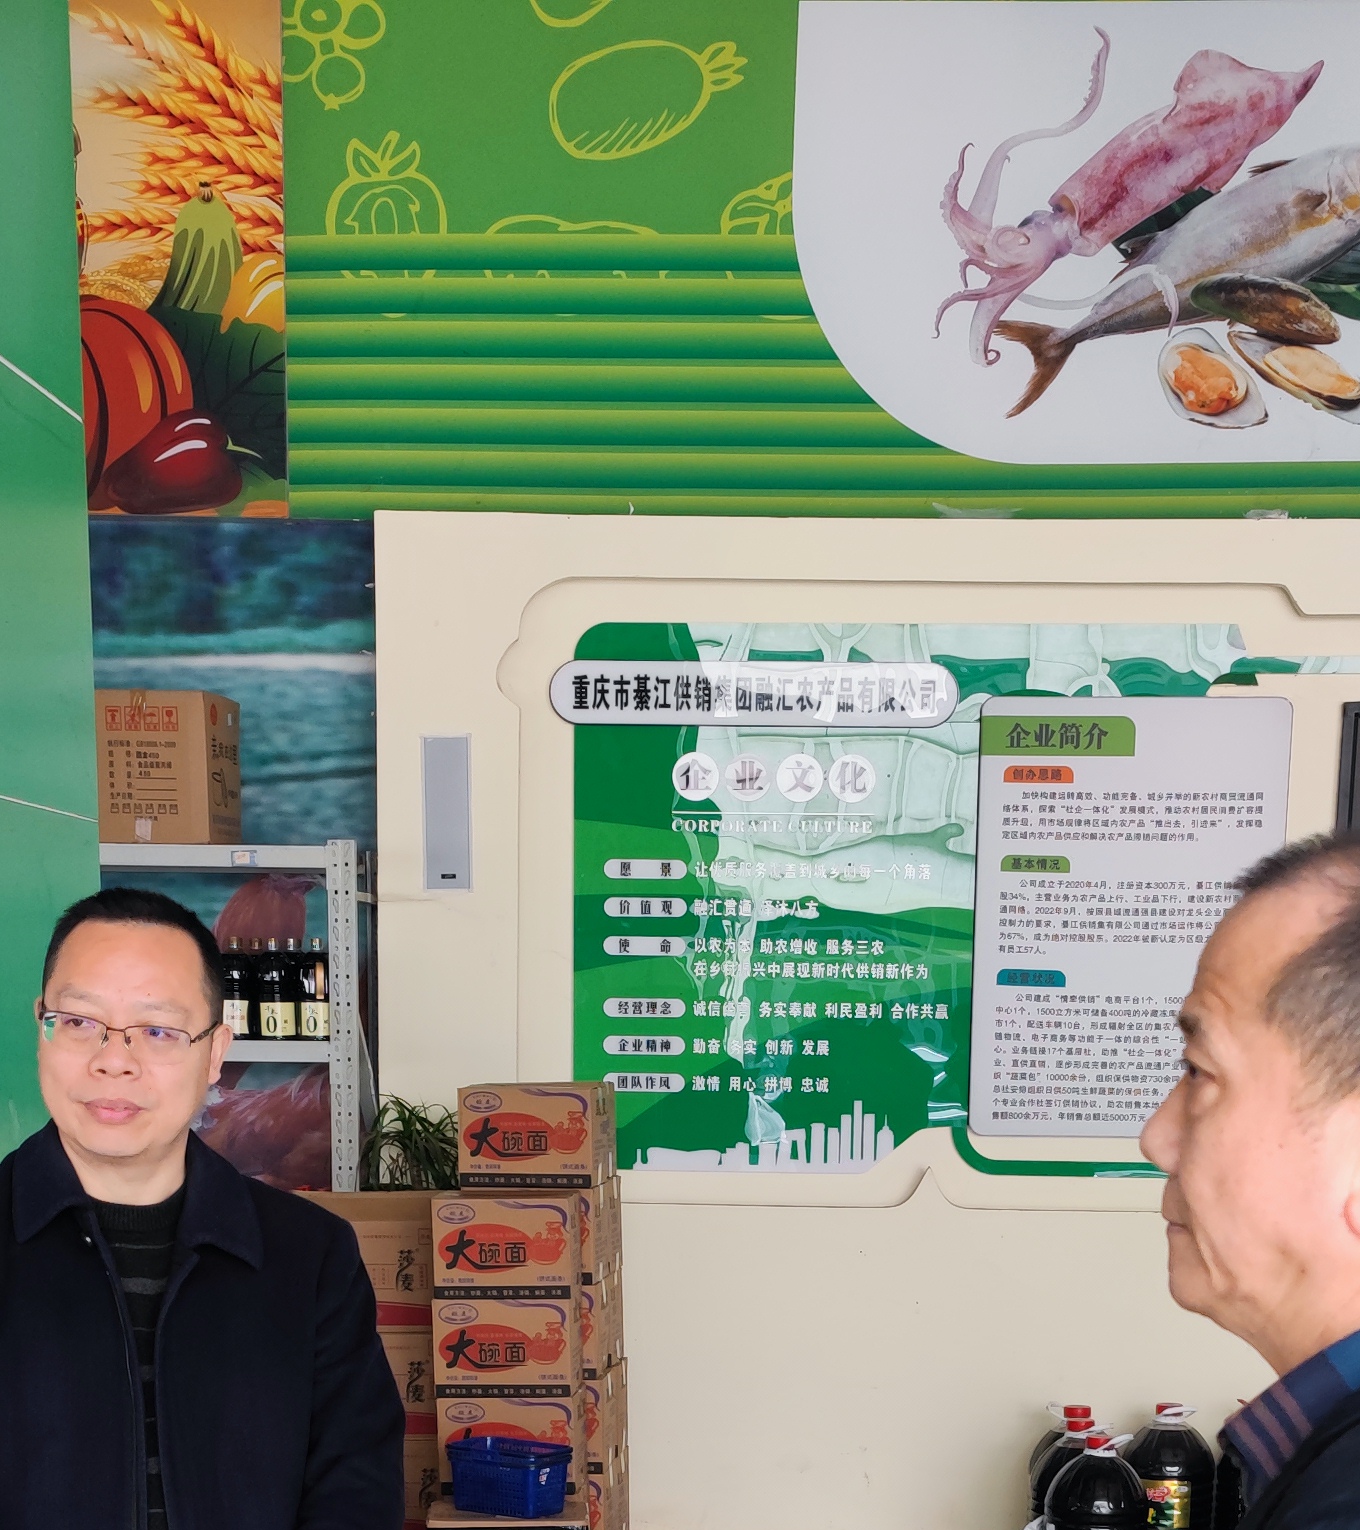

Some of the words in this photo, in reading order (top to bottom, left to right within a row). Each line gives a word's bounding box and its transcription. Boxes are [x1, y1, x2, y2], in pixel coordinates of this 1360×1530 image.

[1005, 722, 1110, 750] 企业简介
[679, 758, 869, 795] 企业文化
[1013, 769, 1062, 781] 创办思路
[671, 818, 783, 833] CORPORATE
[788, 819, 873, 834] CULTURE
[1011, 858, 1061, 870] 基本情况
[619, 899, 672, 915] 价值观
[693, 898, 752, 917] 融汇贯通
[761, 899, 819, 917] 泽沐八方
[619, 938, 671, 954] 使命
[694, 937, 751, 954] 以农为本
[760, 938, 818, 956] 助农增收
[826, 939, 885, 956] 服务三农
[693, 960, 929, 980] 在乡村振兴中展现新时代供销新作为
[1007, 973, 1055, 985] 经营状况
[618, 1001, 672, 1015] 经营理念
[693, 1000, 751, 1018] 诚信经营
[759, 1001, 817, 1018] 务实奉献
[825, 1002, 883, 1019] 利民盈利
[890, 1003, 949, 1020] 合作共赢
[618, 1039, 671, 1052] 企业精神
[692, 1038, 721, 1054] 勤奋
[731, 1039, 757, 1055] 务实
[765, 1039, 793, 1055] 创新
[802, 1040, 830, 1056] 发展
[617, 1075, 671, 1089] 团队作风
[692, 1076, 720, 1092] 激情
[729, 1076, 757, 1092] 用心
[801, 1077, 829, 1093] 忠诚
[470, 1117, 550, 1158] 大碗面
[445, 1229, 528, 1270] 大碗面
[445, 1329, 528, 1369] 大碗面
